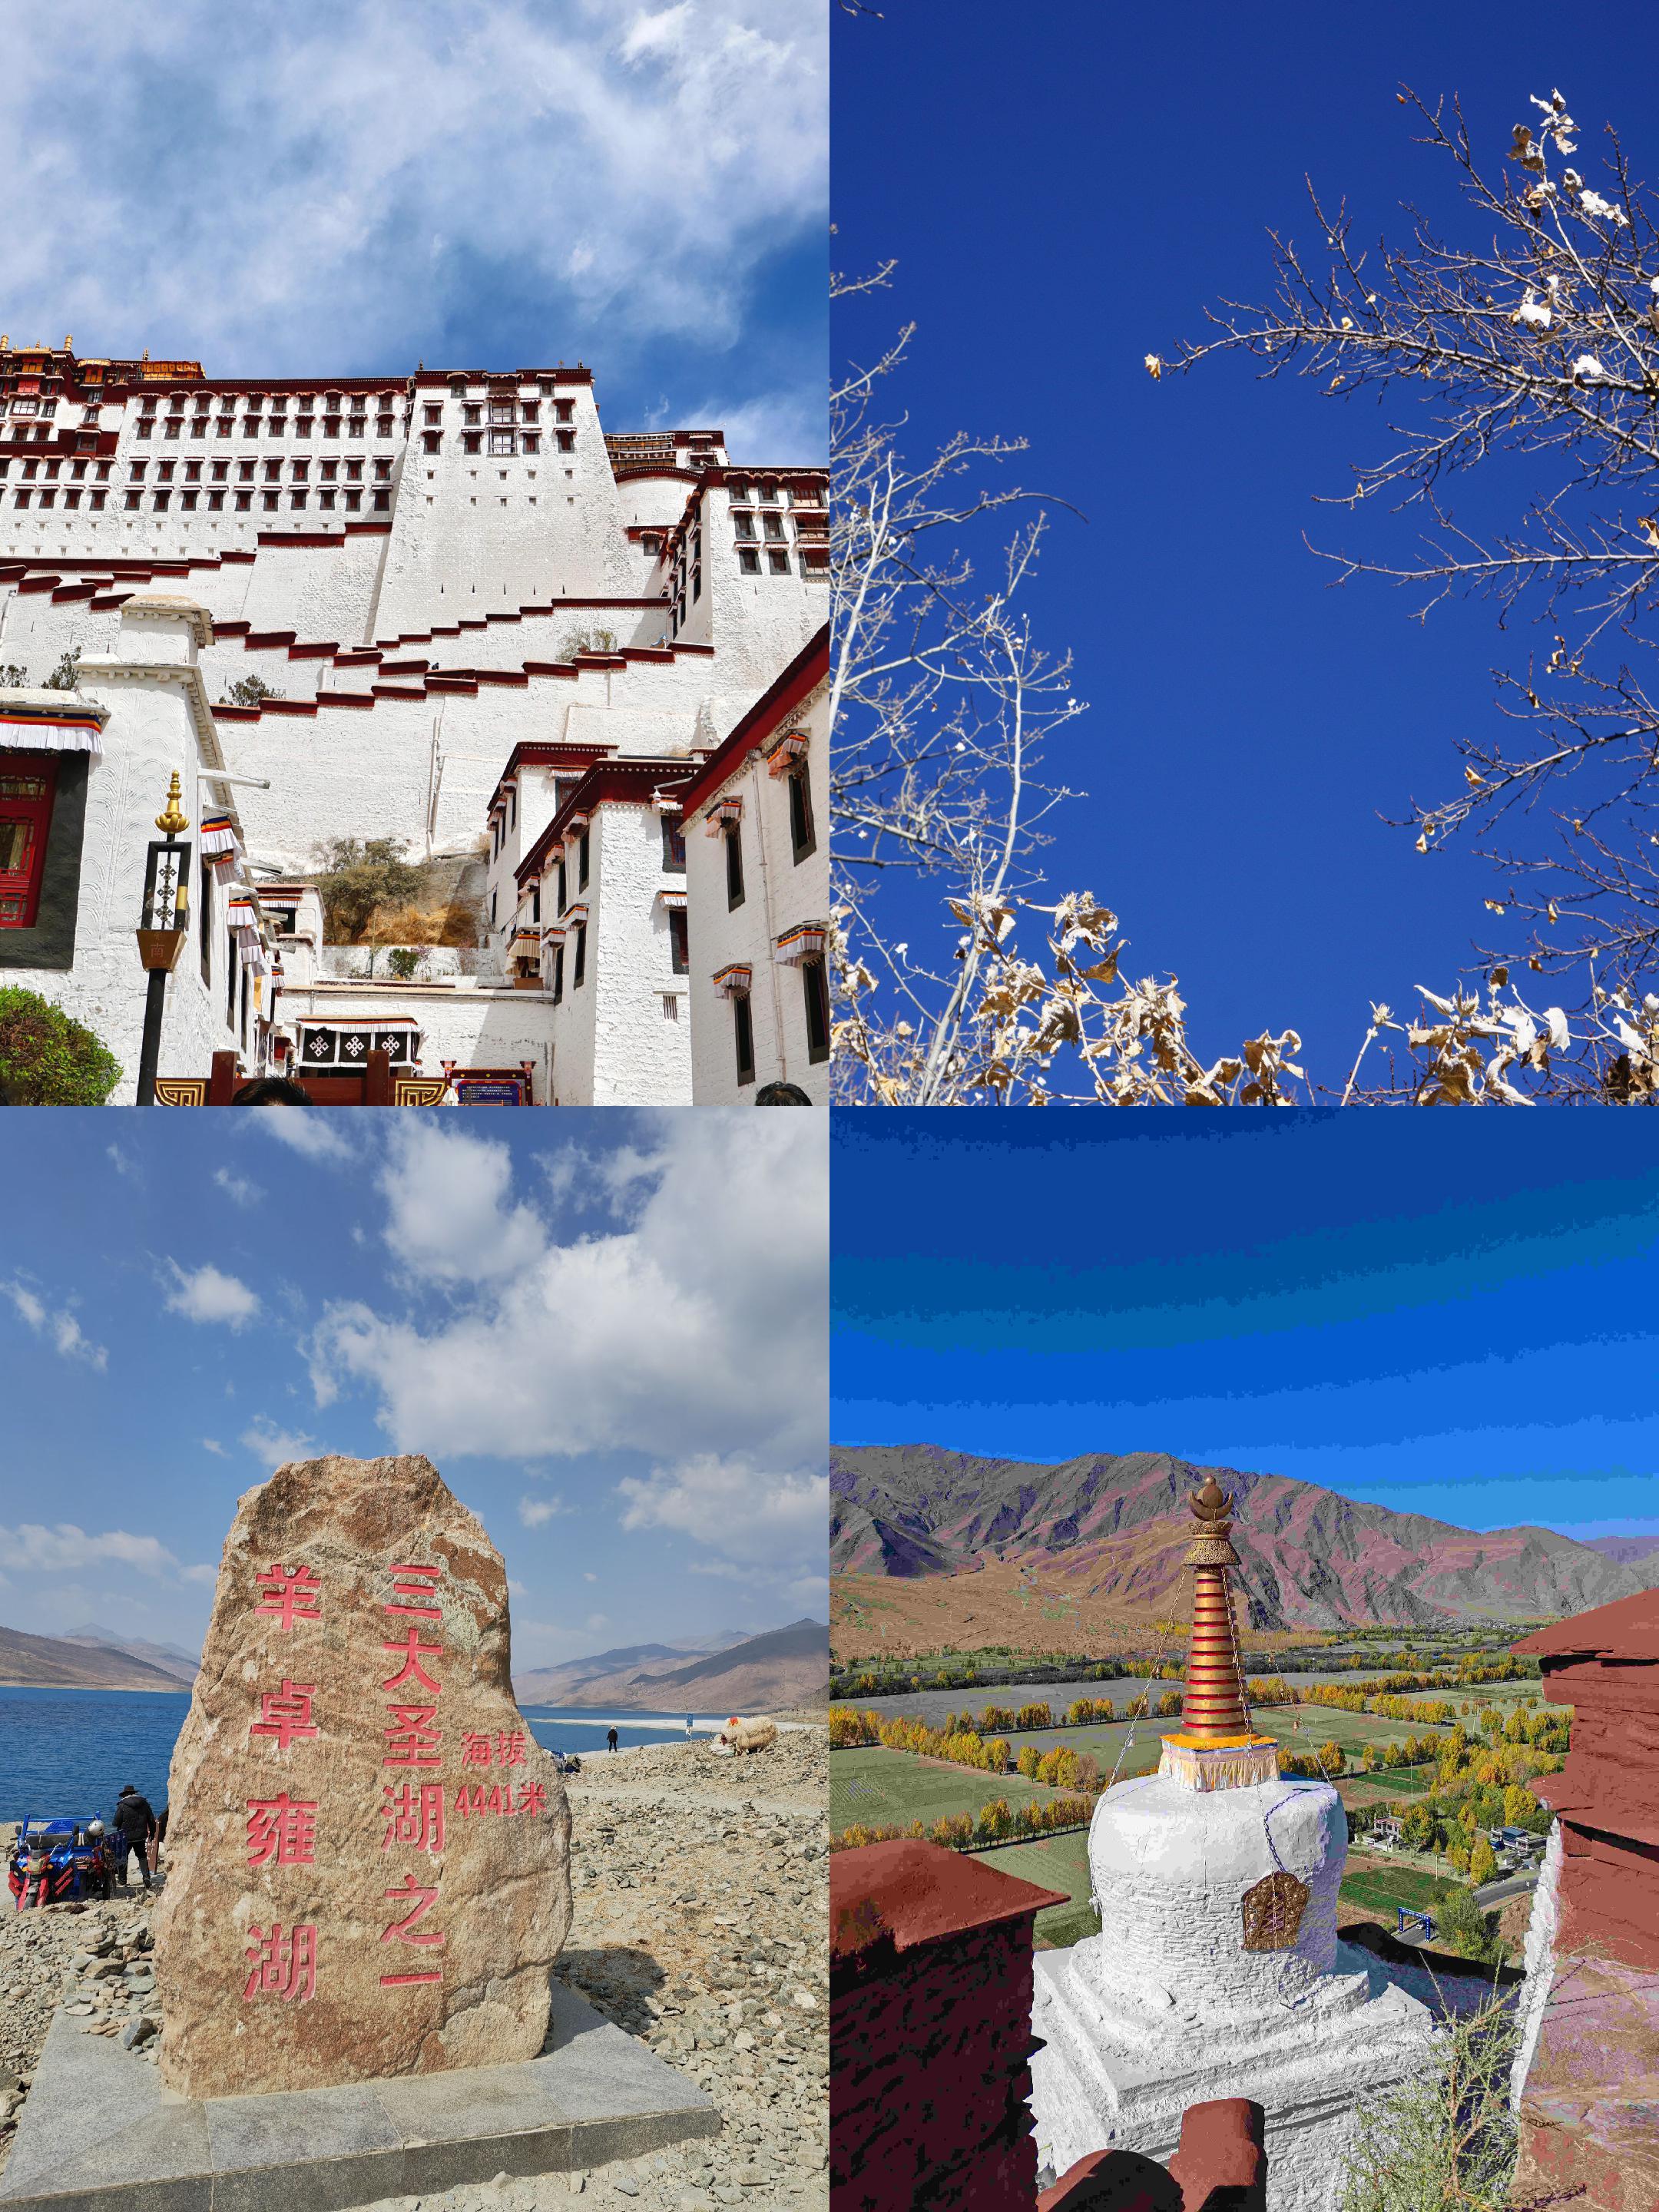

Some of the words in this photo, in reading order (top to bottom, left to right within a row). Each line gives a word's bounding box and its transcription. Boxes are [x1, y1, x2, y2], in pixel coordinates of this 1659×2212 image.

[150, 942, 165, 959] 南
[461, 1730, 528, 1767] 海拔
[242, 1563, 323, 2003] 羊卓雍湖
[379, 1563, 445, 1987] 三大圣湖之一
[454, 1782, 548, 1819] 4441米
